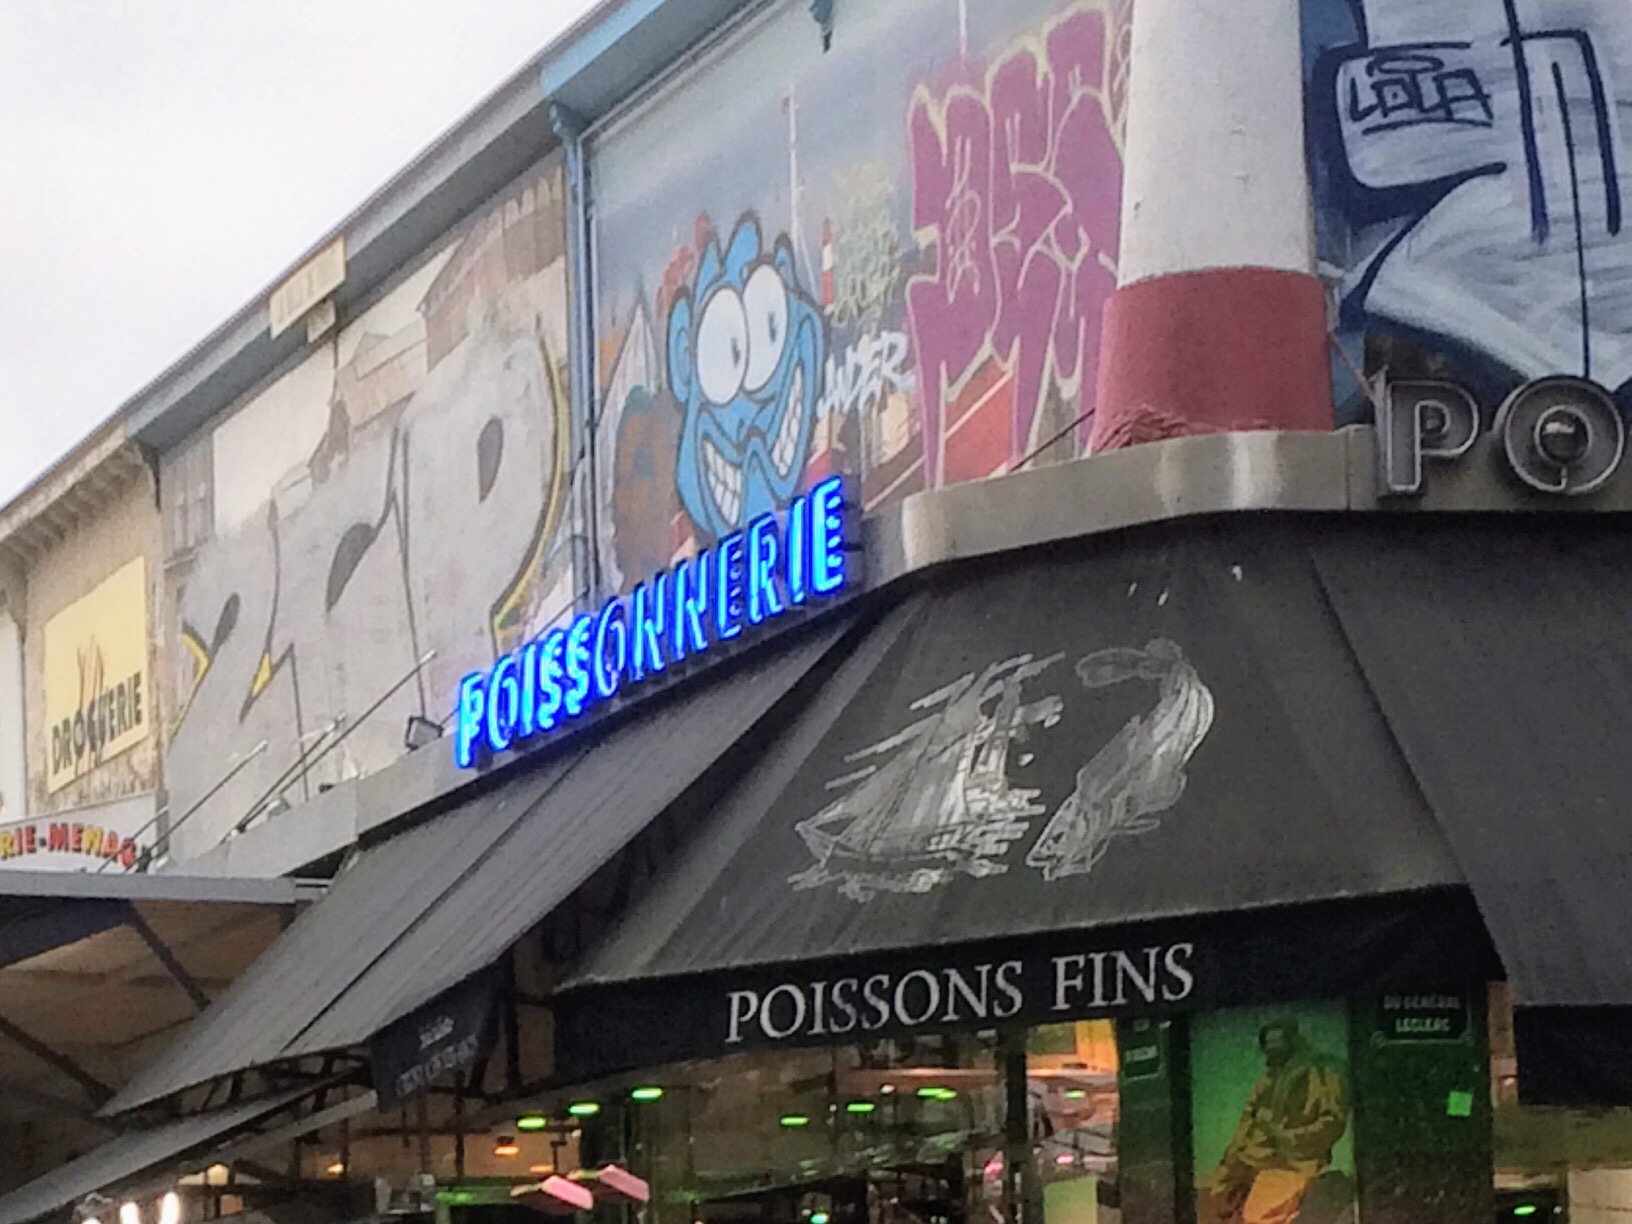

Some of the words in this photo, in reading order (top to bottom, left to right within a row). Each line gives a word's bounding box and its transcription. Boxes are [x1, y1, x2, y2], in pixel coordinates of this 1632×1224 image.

[455, 473, 844, 768] POISSONNERIE
[51, 671, 142, 776] DROGUERIE
[724, 960, 1023, 1045] POISSONS
[1051, 942, 1194, 1011] FINS
